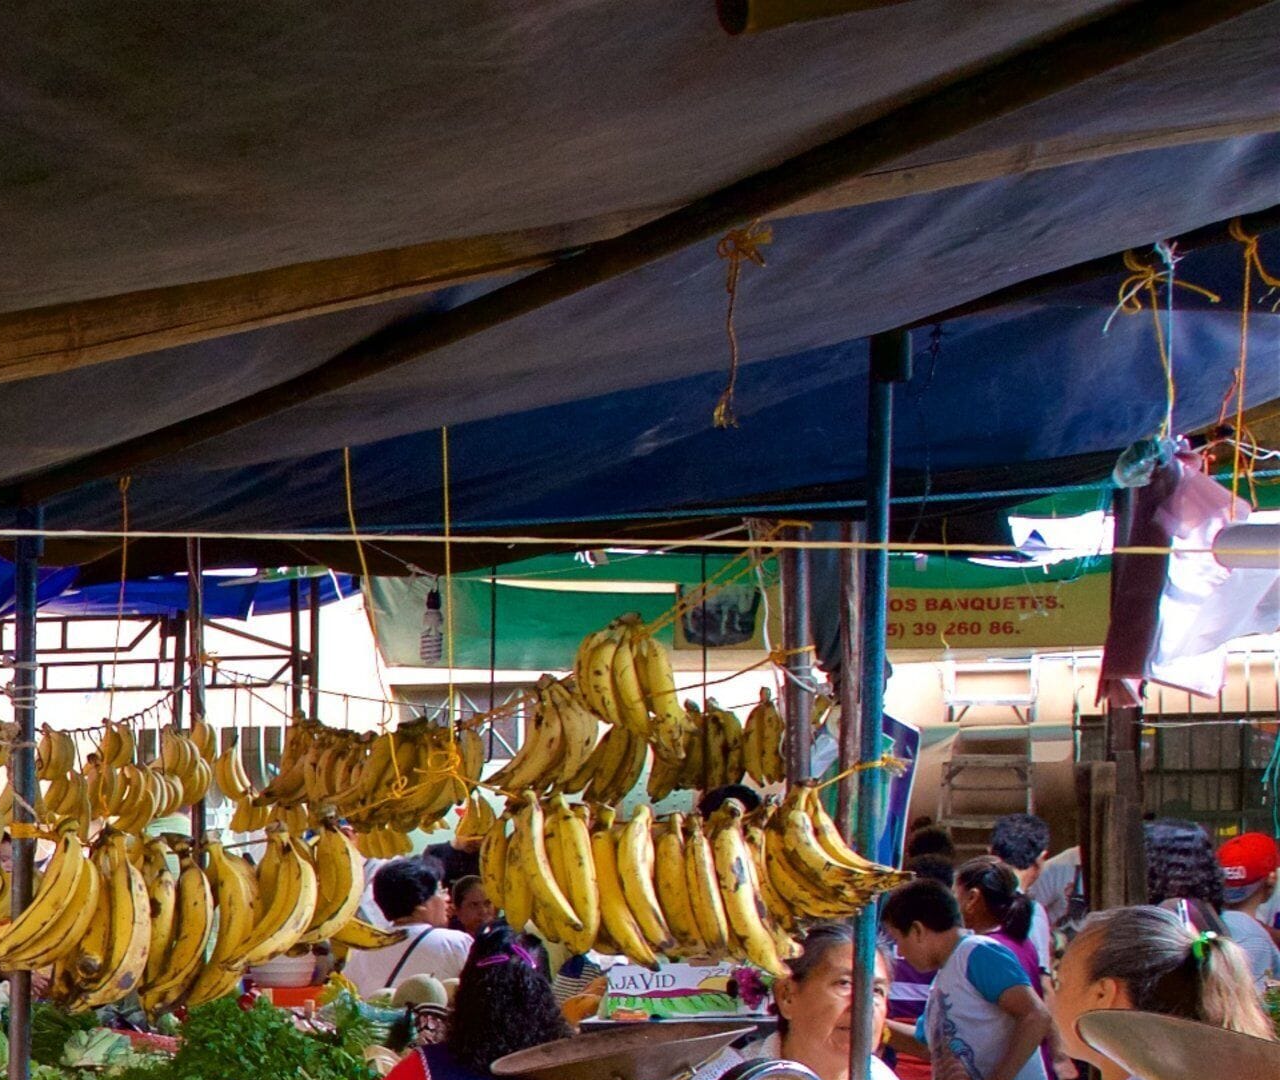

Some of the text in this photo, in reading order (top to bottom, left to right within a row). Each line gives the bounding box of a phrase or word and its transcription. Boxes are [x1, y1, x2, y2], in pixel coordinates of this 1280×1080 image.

[886, 598, 917, 612] OS
[912, 622, 936, 636] 39
[944, 621, 981, 636] 260
[989, 620, 1021, 636] 86.
